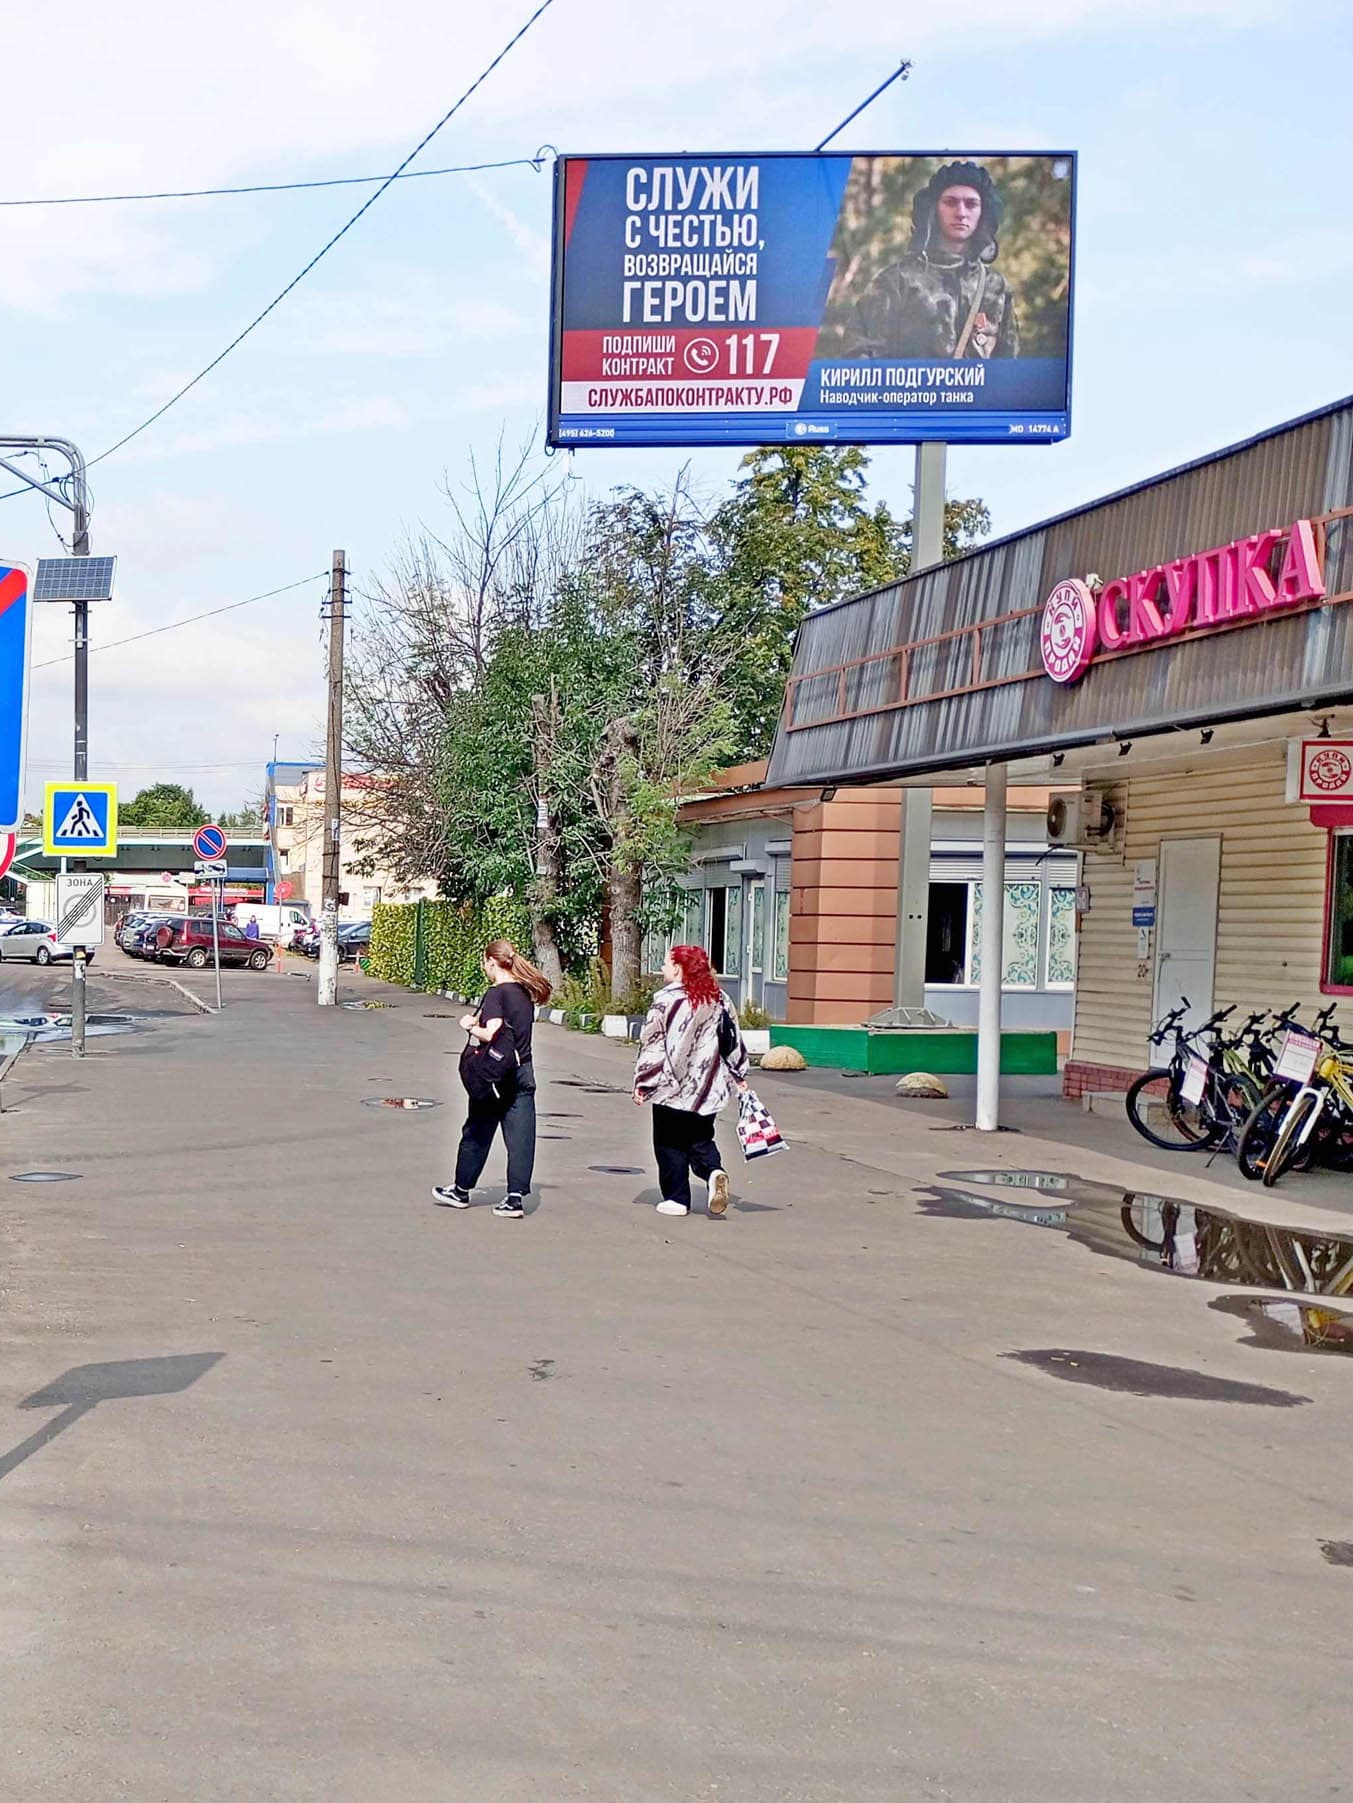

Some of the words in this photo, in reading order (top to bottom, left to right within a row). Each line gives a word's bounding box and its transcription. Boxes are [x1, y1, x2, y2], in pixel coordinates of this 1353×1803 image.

[626, 166, 759, 211] СЛУЖИ
[625, 215, 641, 248] С
[649, 214, 765, 250] ЧЕСТЬЮ,
[624, 249, 757, 278] ВОЗВРАЩАЙСЯ
[622, 280, 757, 322] ГЕРОЕМ
[602, 335, 676, 356] ПОДПИШИ
[725, 333, 780, 375] 117
[602, 357, 675, 376] КОНТРАКТ
[821, 368, 881, 387] КИРИЛЛ
[886, 363, 985, 388] ПОДГУРСКИЙ
[588, 386, 793, 407] СЛУЖБАПОКОНТРАКТУ.РФ
[820, 389, 937, 406] Наводчик-оператор
[941, 391, 974, 404] танка
[1098, 519, 1326, 649] СКУПКА
[66, 878, 93, 887] ЗОНА
